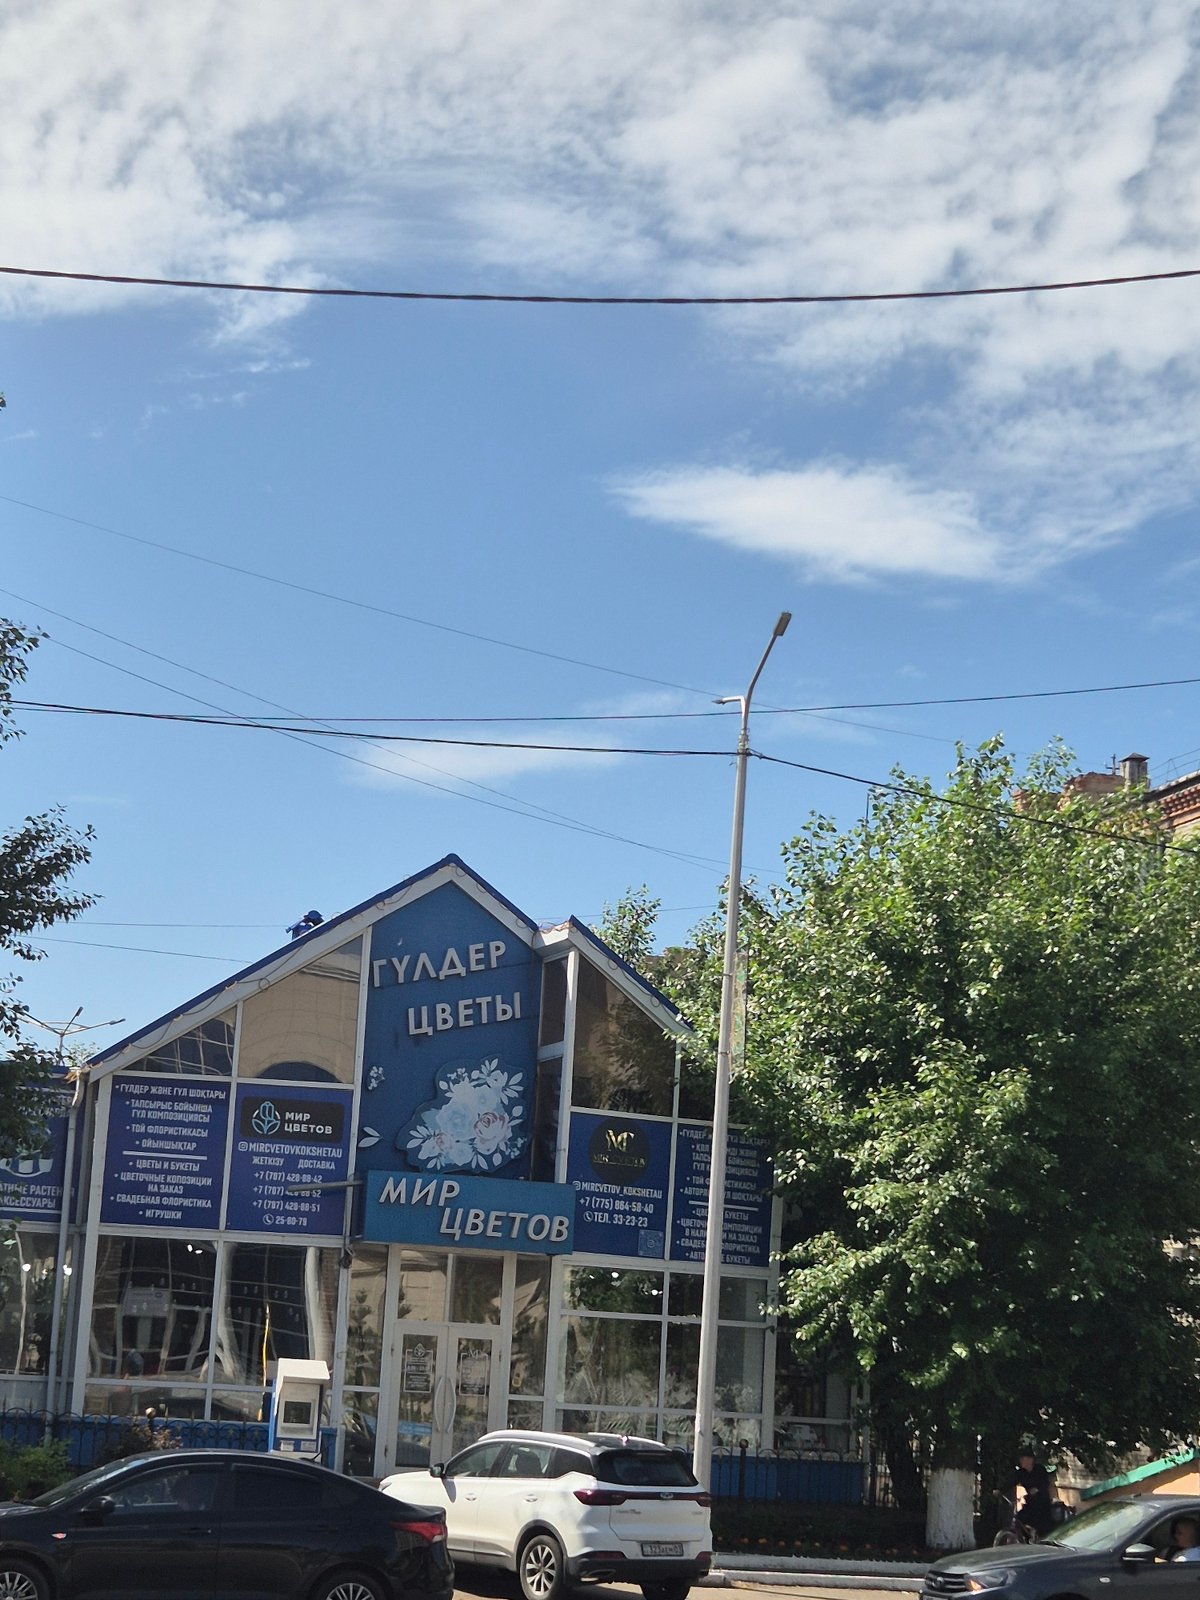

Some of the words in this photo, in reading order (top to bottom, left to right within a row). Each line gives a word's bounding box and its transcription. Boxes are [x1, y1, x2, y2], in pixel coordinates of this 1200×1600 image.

[372, 940, 507, 988] ГҮЛДЕР
[407, 991, 522, 1036] ЦВЕТЫ
[131, 1099, 173, 1110] ТАПСЫРЫС
[147, 1111, 210, 1123] КОМПОЗИЦИЯСЫ
[285, 1111, 311, 1121] МИР
[132, 1123, 146, 1133] ТОЙ
[146, 1125, 209, 1137] ФЛОРИСТИКАСЫ
[284, 1123, 333, 1135] ЦВЕТОВ
[248, 1142, 343, 1158] MIRCVETOVKOKSHETAU
[136, 1159, 162, 1170] ЦВЕТЫ
[163, 1161, 169, 1170] И
[170, 1161, 200, 1172] БУКЕТЫ
[297, 1159, 336, 1170] ДОСТАВКА
[120, 1171, 166, 1183] ЦВЕТОЧНЫЕ
[253, 1171, 264, 1180] +7
[147, 1184, 159, 1193] НА
[159, 1184, 184, 1194] ЗАКАЗ
[253, 1185, 263, 1194] +7
[378, 1176, 460, 1207] МИР
[116, 1193, 160, 1205] СВАДЕБНАЯ
[161, 1197, 212, 1208] ФЛОРИСТИКА
[252, 1199, 263, 1208] +7
[579, 1197, 590, 1207] +7
[591, 1197, 613, 1210] (775)
[145, 1209, 182, 1219] ИГРУШКИ
[593, 1211, 611, 1224] ТЕЛ.
[612, 1213, 648, 1227] 33-23-23
[439, 1207, 571, 1241] ЦВЕТОВ
